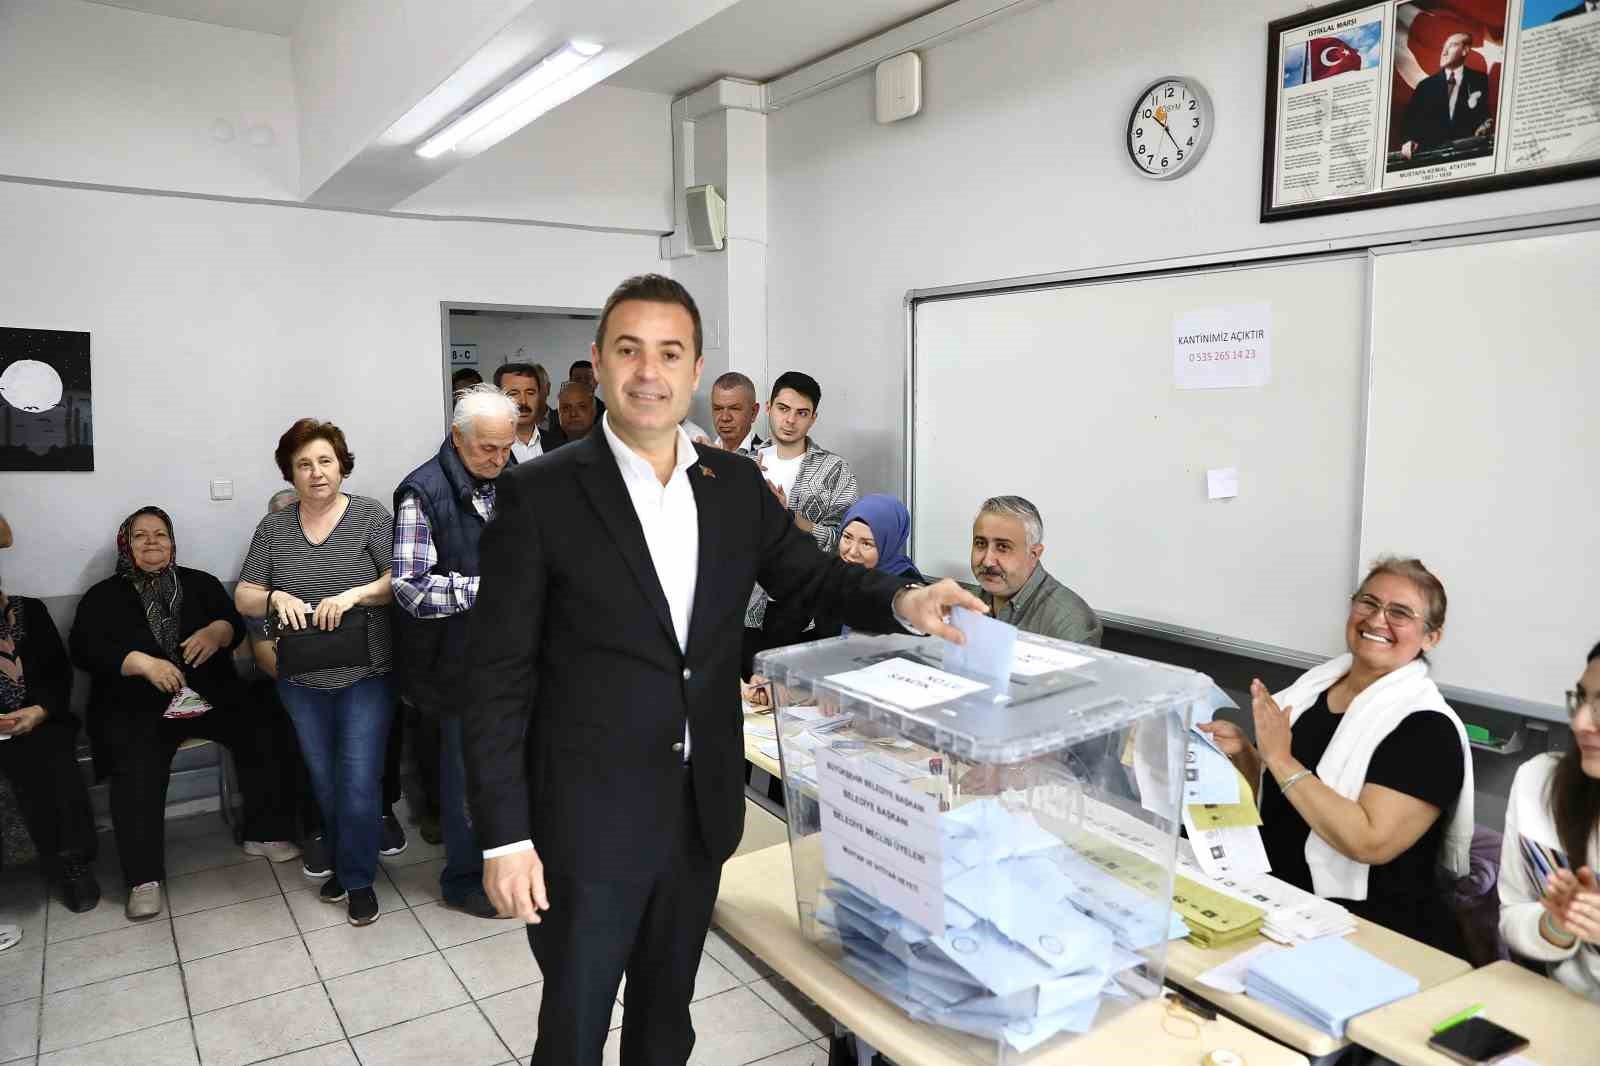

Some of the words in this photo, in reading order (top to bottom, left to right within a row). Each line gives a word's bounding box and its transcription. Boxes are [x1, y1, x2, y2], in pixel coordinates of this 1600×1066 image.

[1164, 87, 1175, 99] 12
[1151, 95, 1158, 106] 11
[1188, 100, 1197, 110] 2
[1142, 108, 1152, 119] 10
[1192, 117, 1200, 128] 3
[1135, 127, 1143, 138] 9
[1186, 136, 1194, 146] 4
[1138, 144, 1146, 154] 8
[1146, 154, 1154, 165] 7
[1176, 149, 1184, 161] 5
[1160, 156, 1169, 167] 6
[1230, 328, 1264, 343] AÇIKTIR
